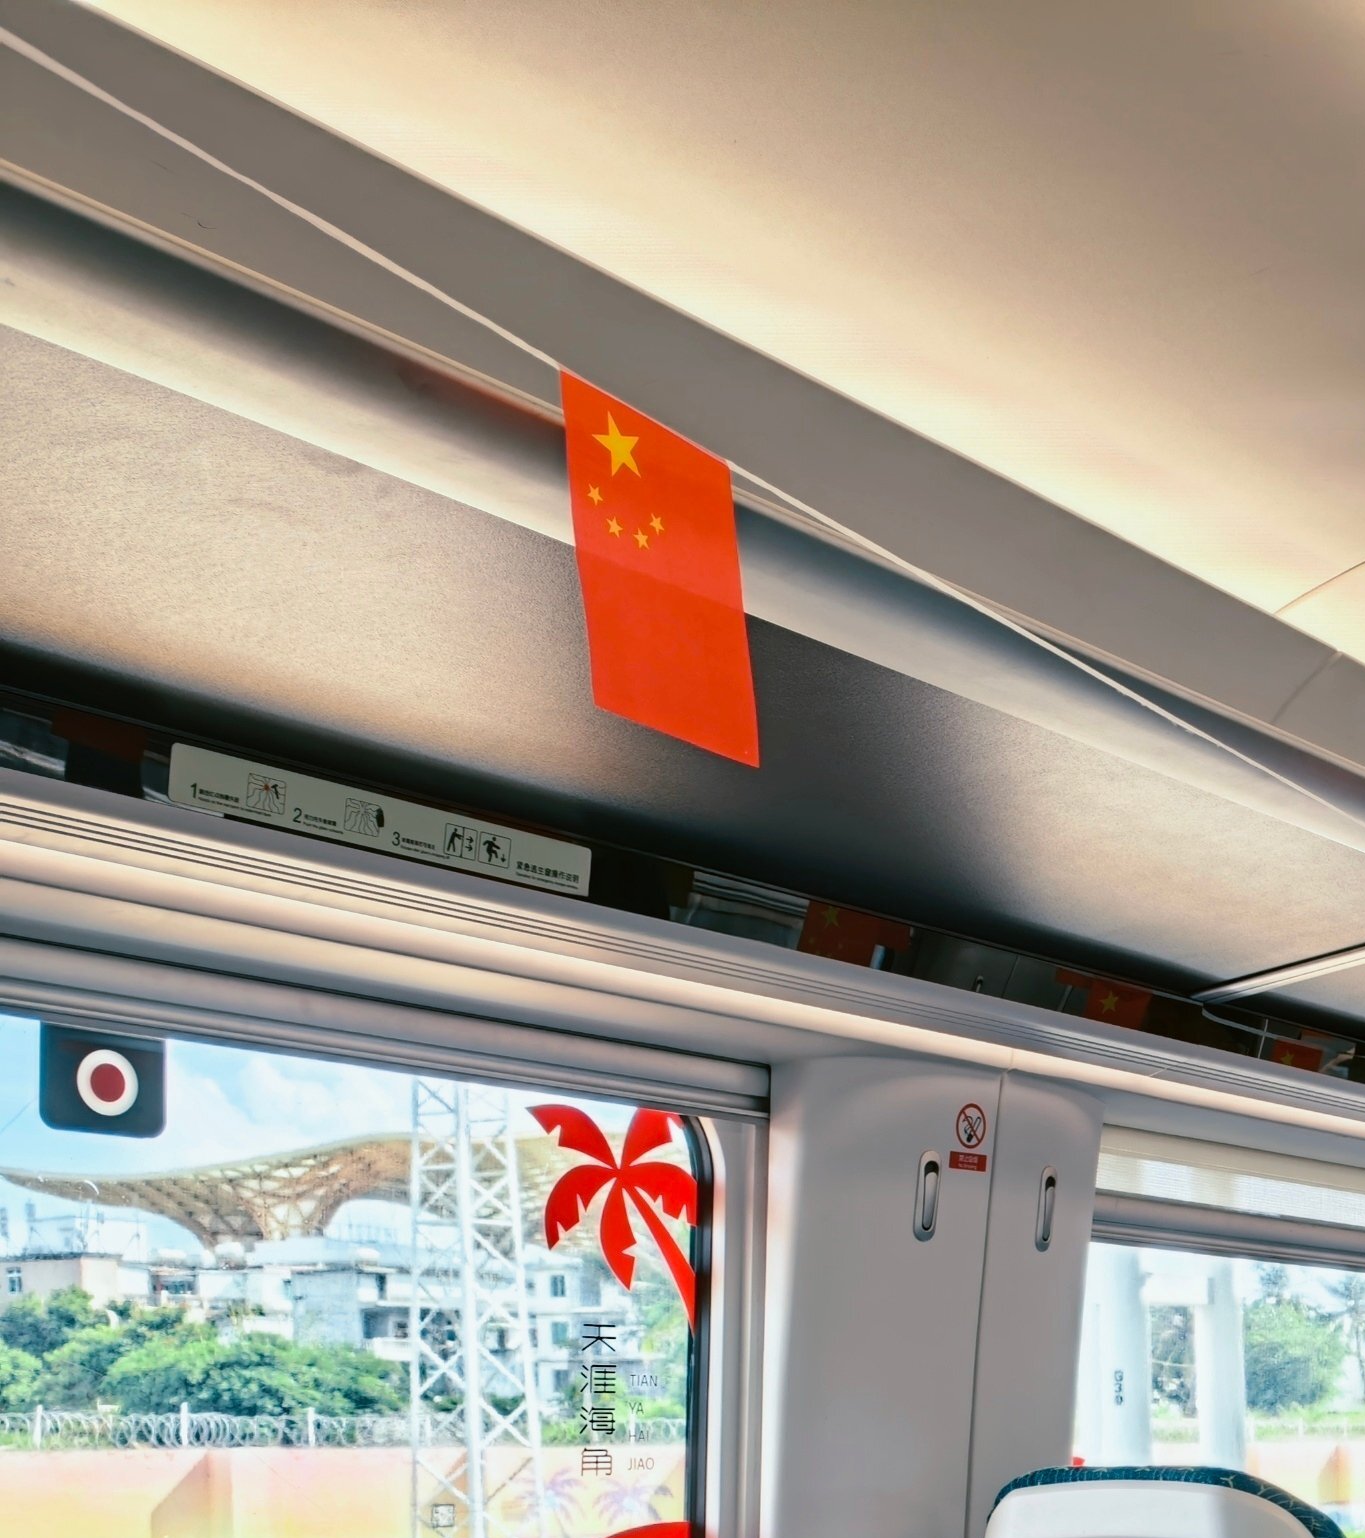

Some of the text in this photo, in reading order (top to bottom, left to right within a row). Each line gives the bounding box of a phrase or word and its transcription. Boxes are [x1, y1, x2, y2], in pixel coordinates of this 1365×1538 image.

[629, 1374, 658, 1388] TIAN
[580, 1323, 617, 1477] 天涯海角
[628, 1402, 645, 1415] YA
[628, 1430, 650, 1443] HAI
[627, 1457, 655, 1471] JIAO
